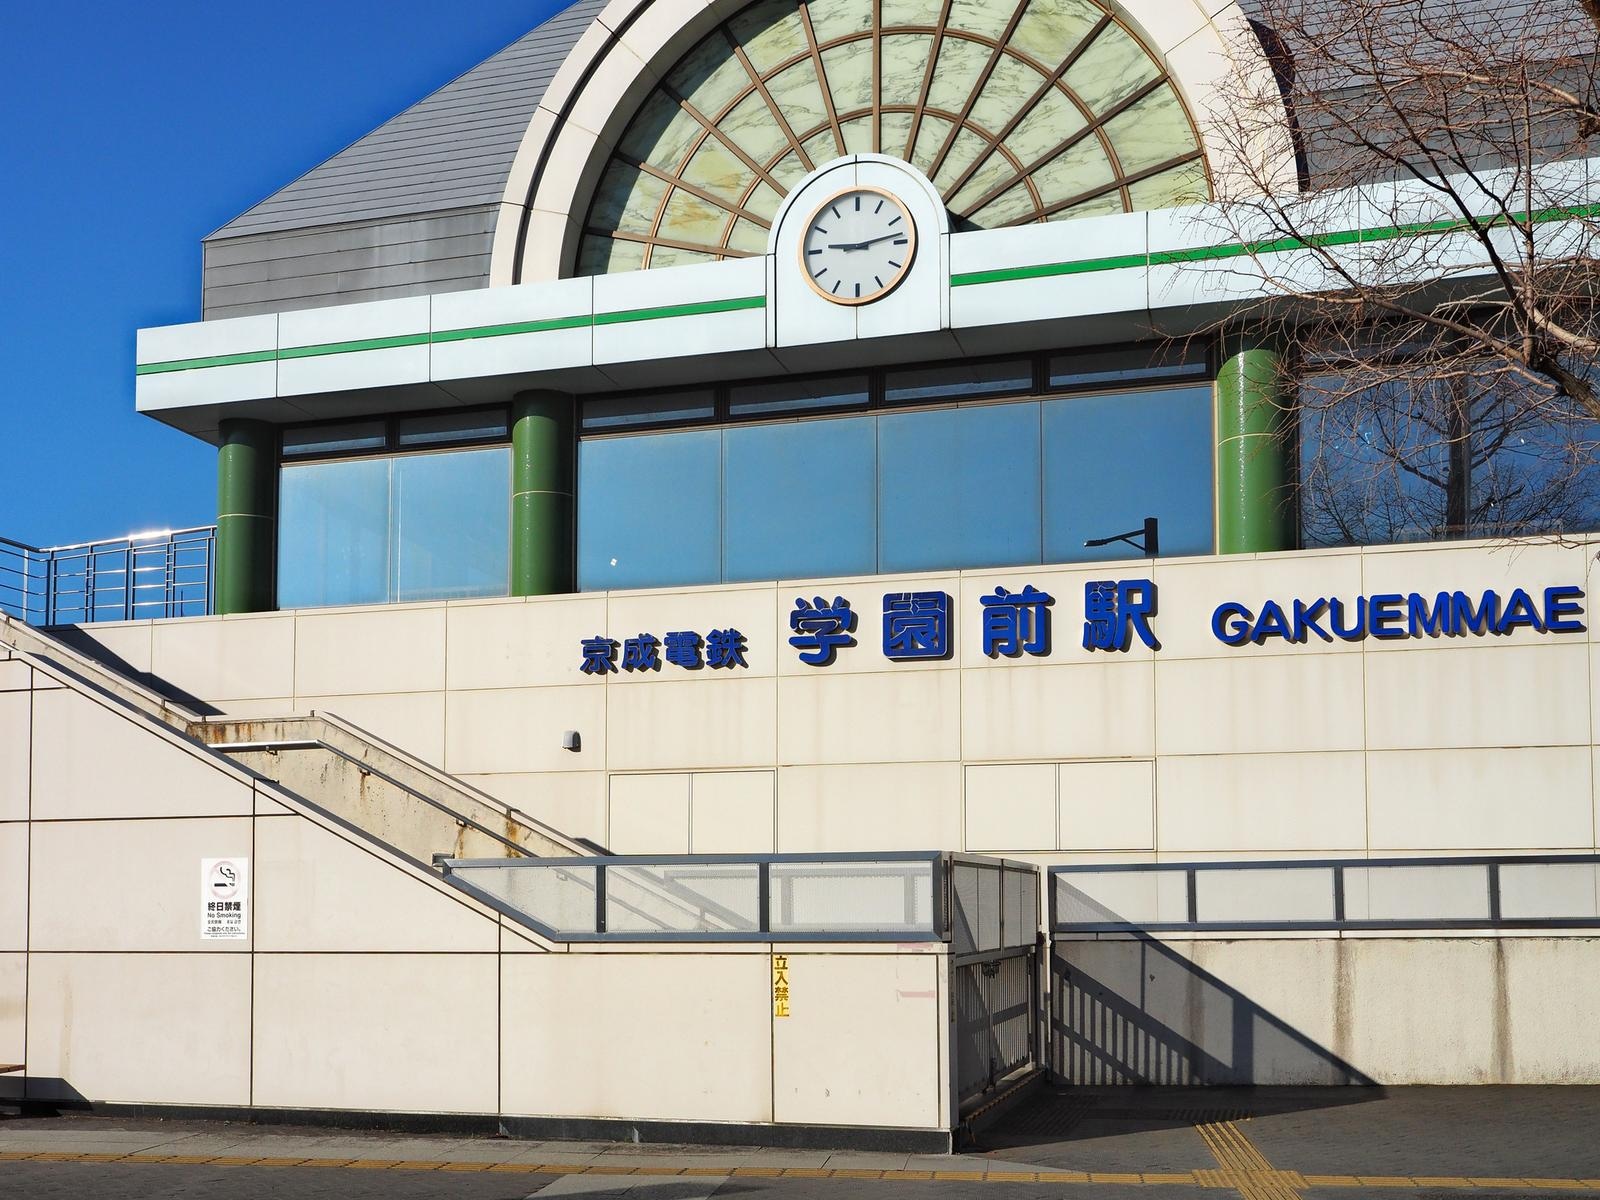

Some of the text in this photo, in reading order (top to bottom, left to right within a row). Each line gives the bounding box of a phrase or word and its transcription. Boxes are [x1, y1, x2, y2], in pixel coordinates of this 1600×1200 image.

[580, 579, 1158, 675] 京成電鉄 学園前駅
[1211, 586, 1584, 643] GAKUEMMAE
[208, 902, 241, 911] 終日禁煙
[774, 955, 790, 1017] 立入禁止
